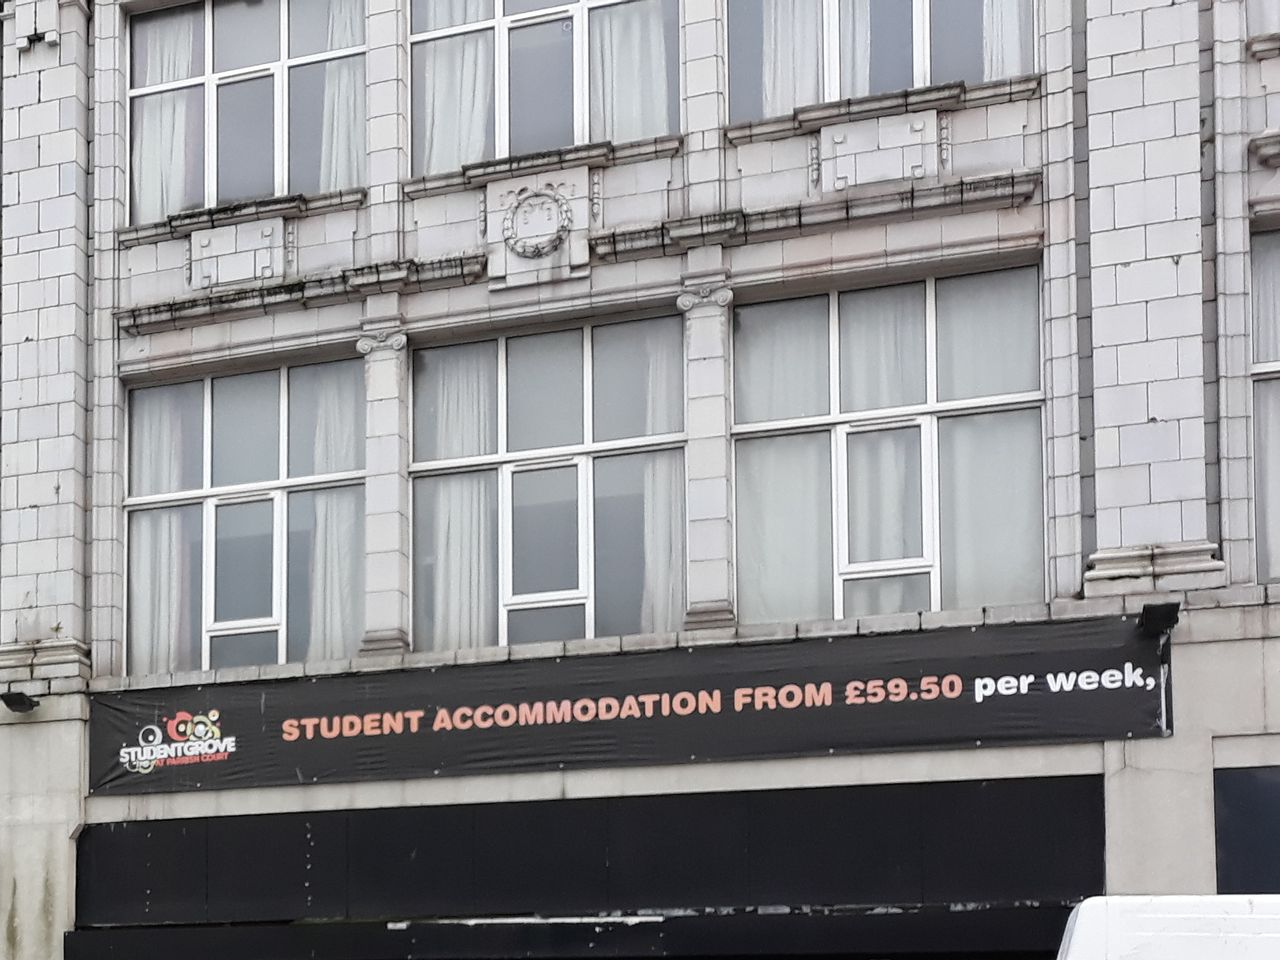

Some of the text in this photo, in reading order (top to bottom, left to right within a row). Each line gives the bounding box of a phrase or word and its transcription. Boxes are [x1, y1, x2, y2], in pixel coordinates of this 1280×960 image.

[282, 661, 1156, 742] STUDENT ACCOMMODATION FROM £59.50 per week,
